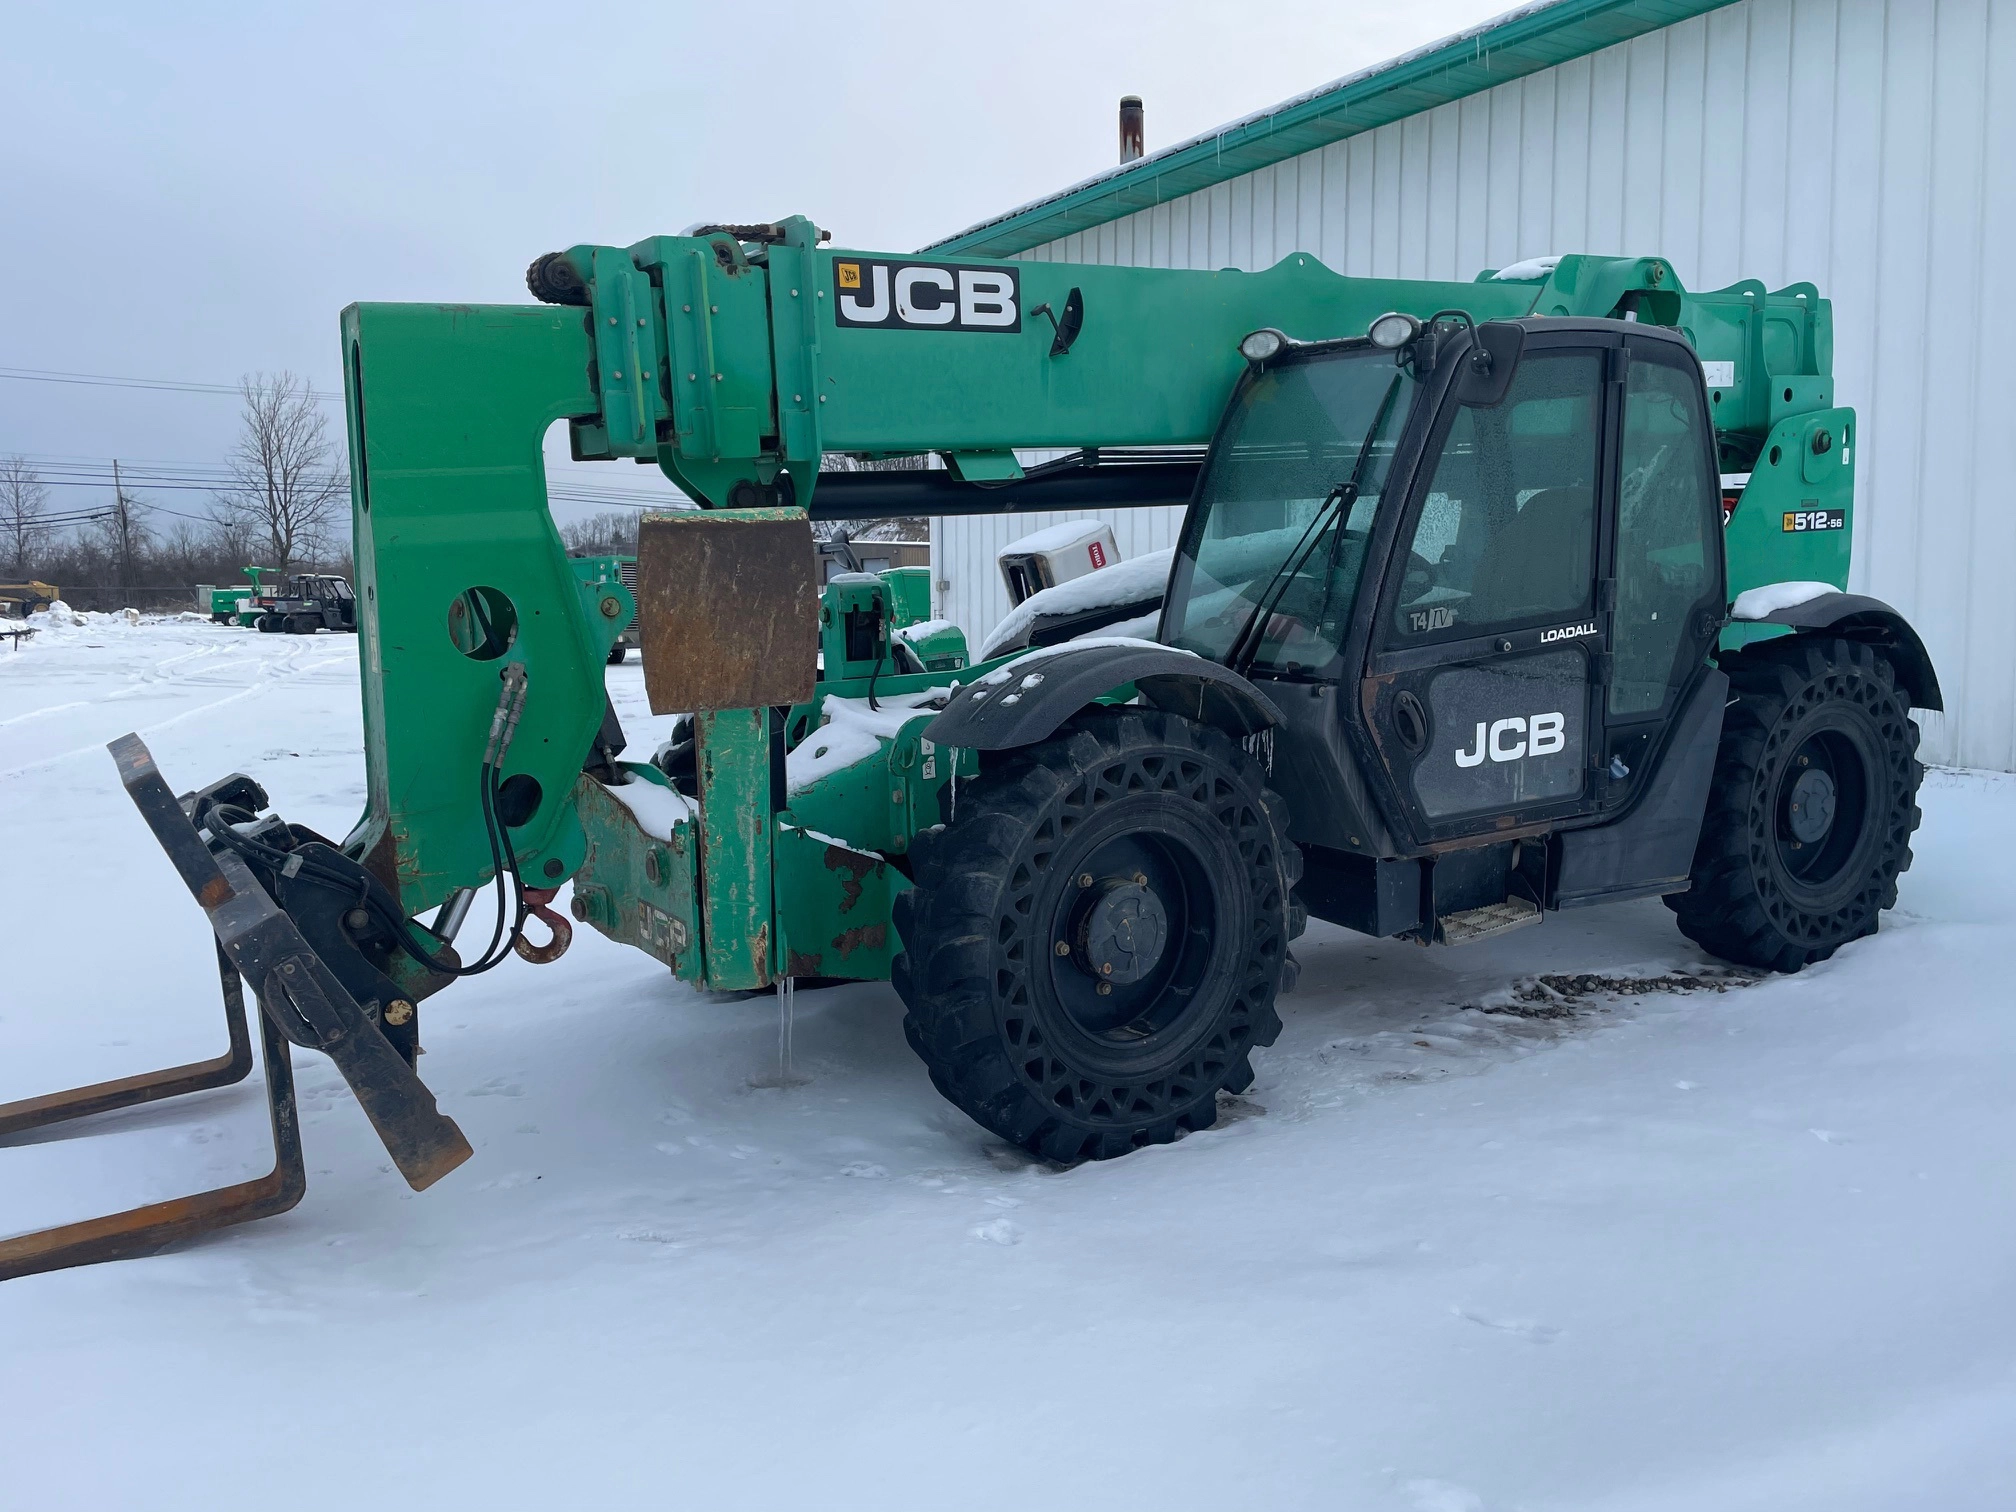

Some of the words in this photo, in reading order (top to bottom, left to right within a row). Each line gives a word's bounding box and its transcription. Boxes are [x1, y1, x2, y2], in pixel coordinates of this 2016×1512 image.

[840, 265, 1017, 326] JCB
[1092, 544, 1102, 567] TORO
[1540, 622, 1598, 643] LOADALL
[1455, 712, 1565, 768] JCB
